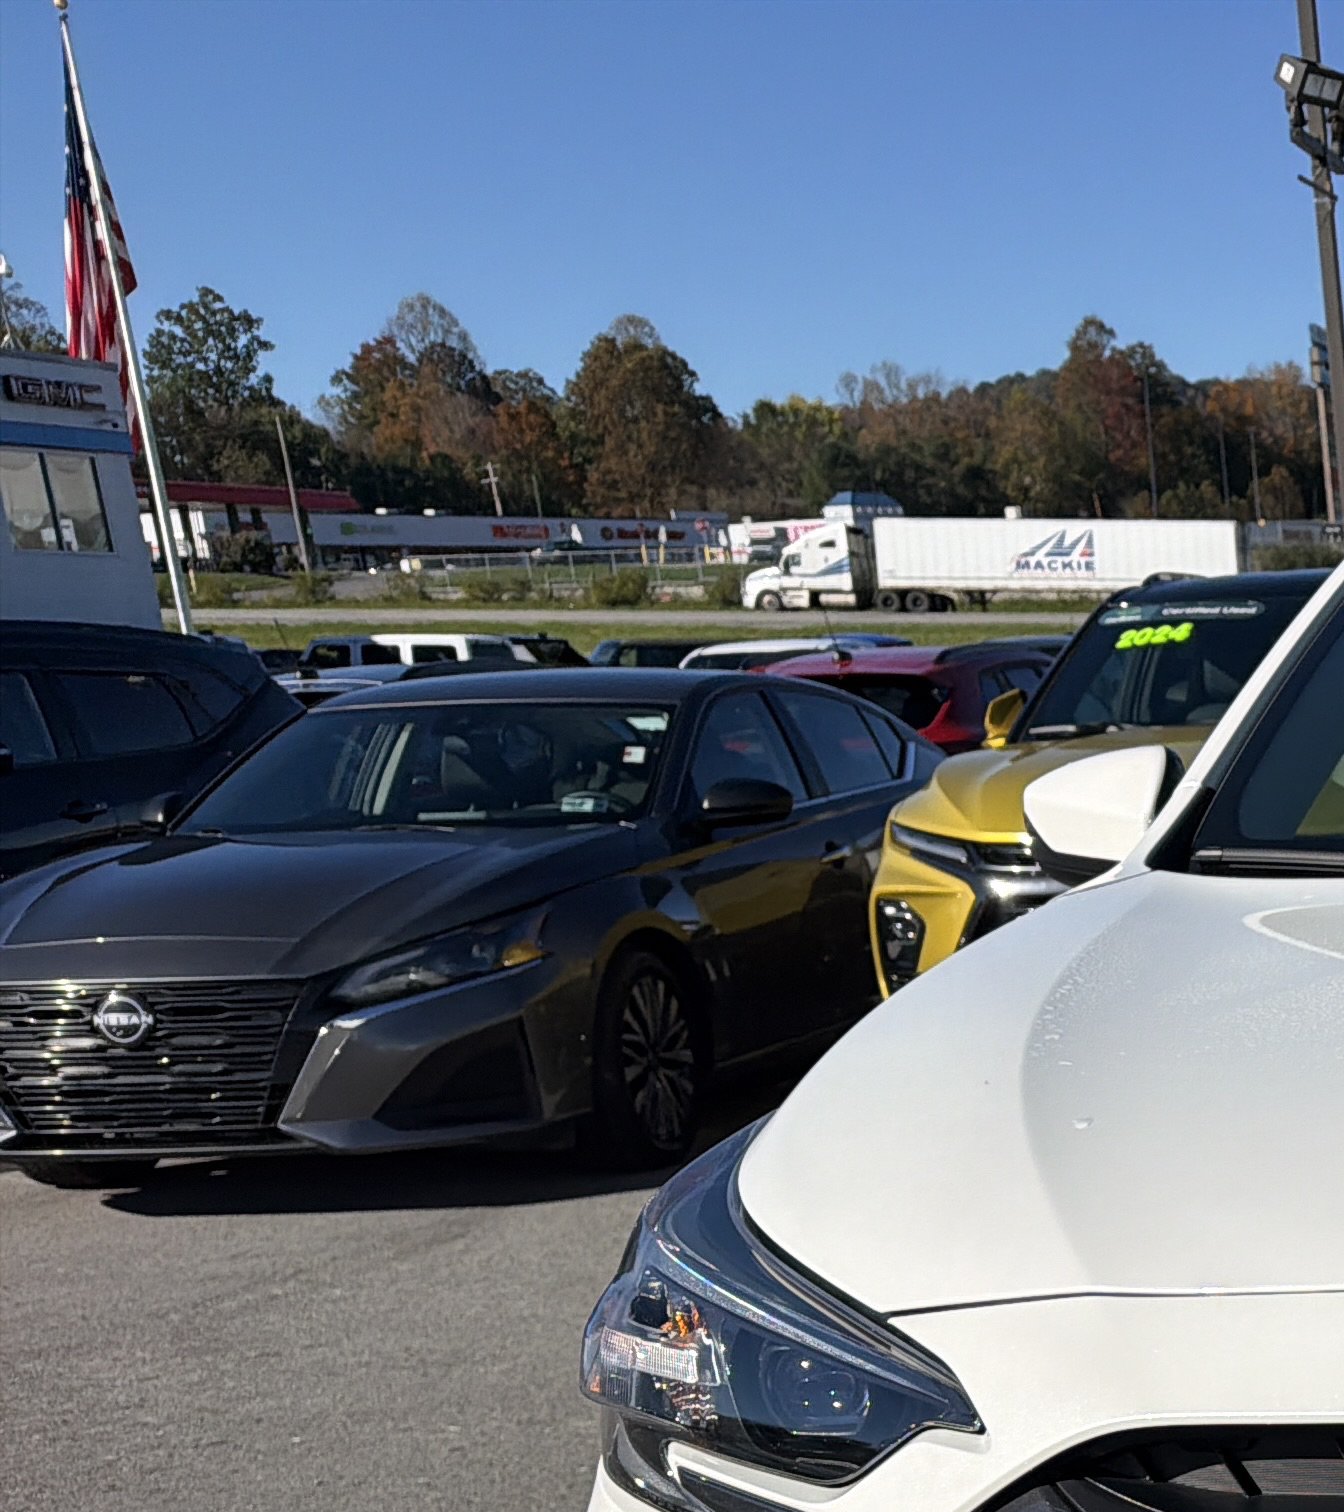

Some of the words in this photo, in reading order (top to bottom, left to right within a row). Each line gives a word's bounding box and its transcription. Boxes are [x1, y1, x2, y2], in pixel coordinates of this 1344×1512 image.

[3, 374, 106, 412] GMC
[1015, 559, 1096, 572] MACKIE
[1115, 622, 1194, 649] 2024
[93, 1013, 154, 1027] NISSAN
